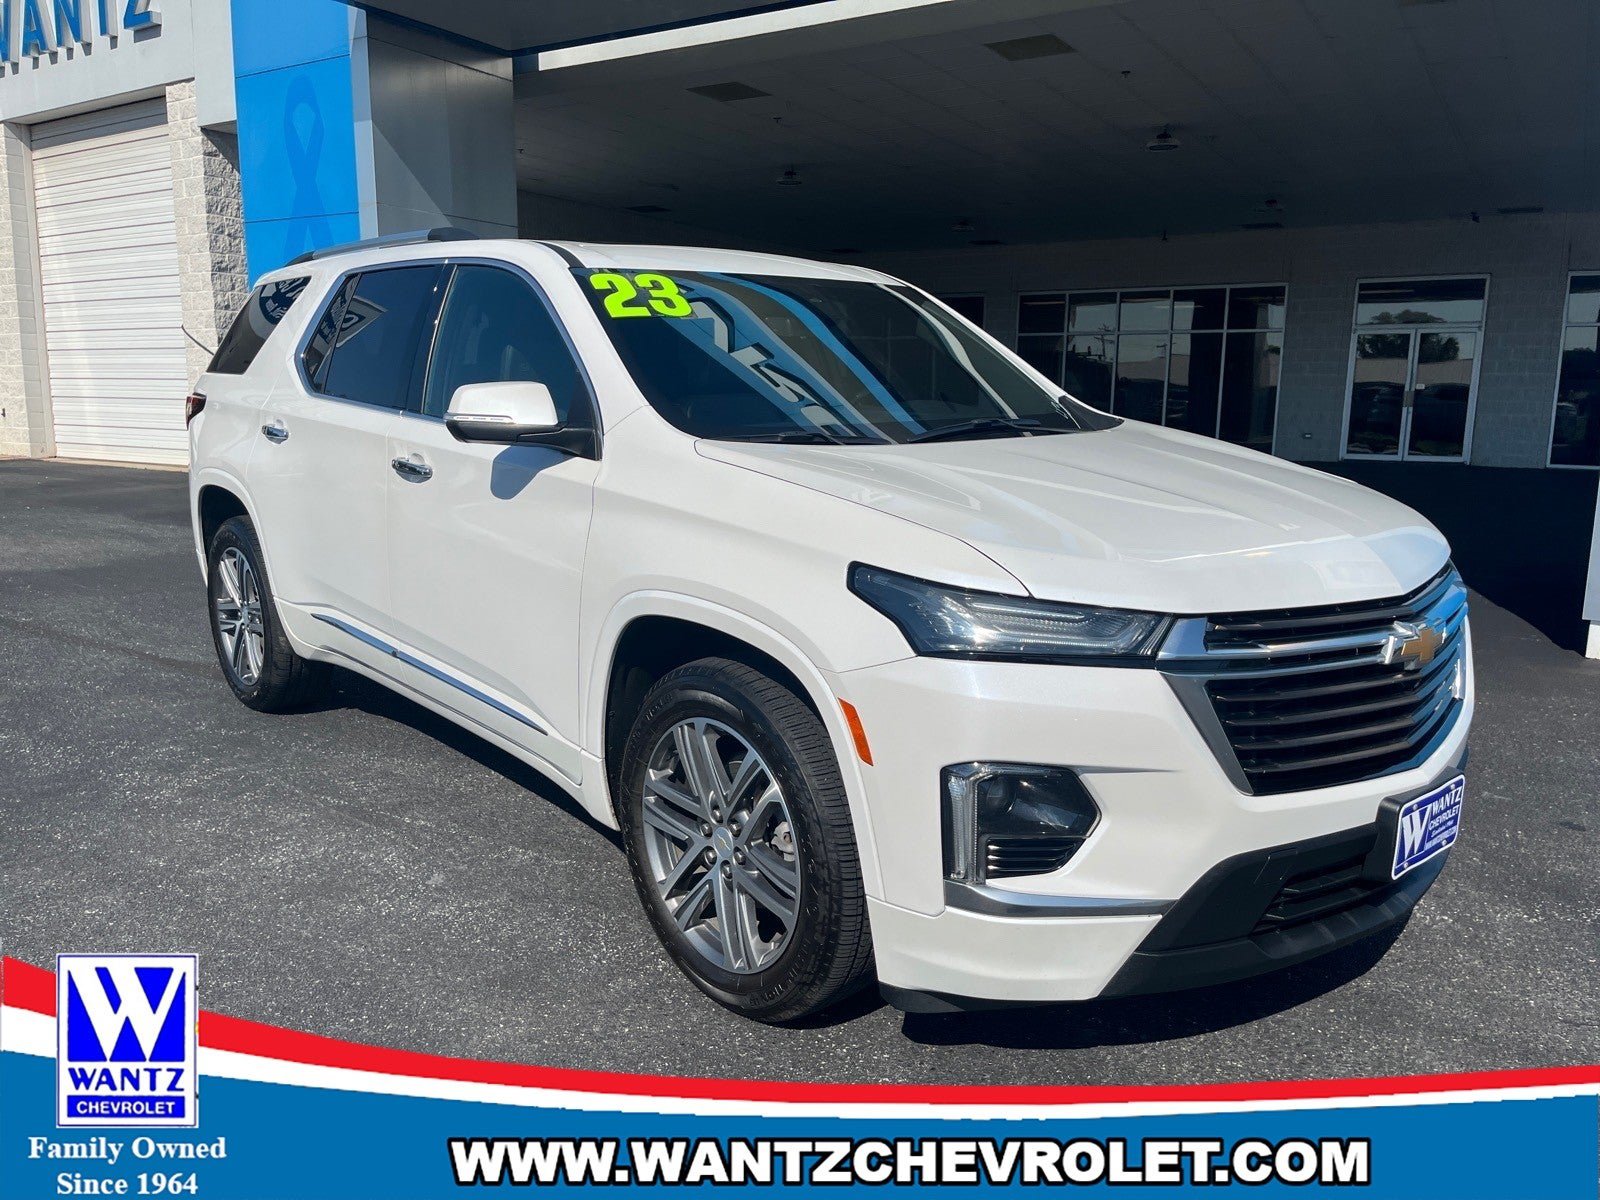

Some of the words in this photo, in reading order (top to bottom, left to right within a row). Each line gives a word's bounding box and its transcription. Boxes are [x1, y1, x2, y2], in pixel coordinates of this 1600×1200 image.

[589, 272, 693, 319] 23
[1433, 786, 1463, 816] WANTZ
[1428, 804, 1460, 831] CHEVROLET
